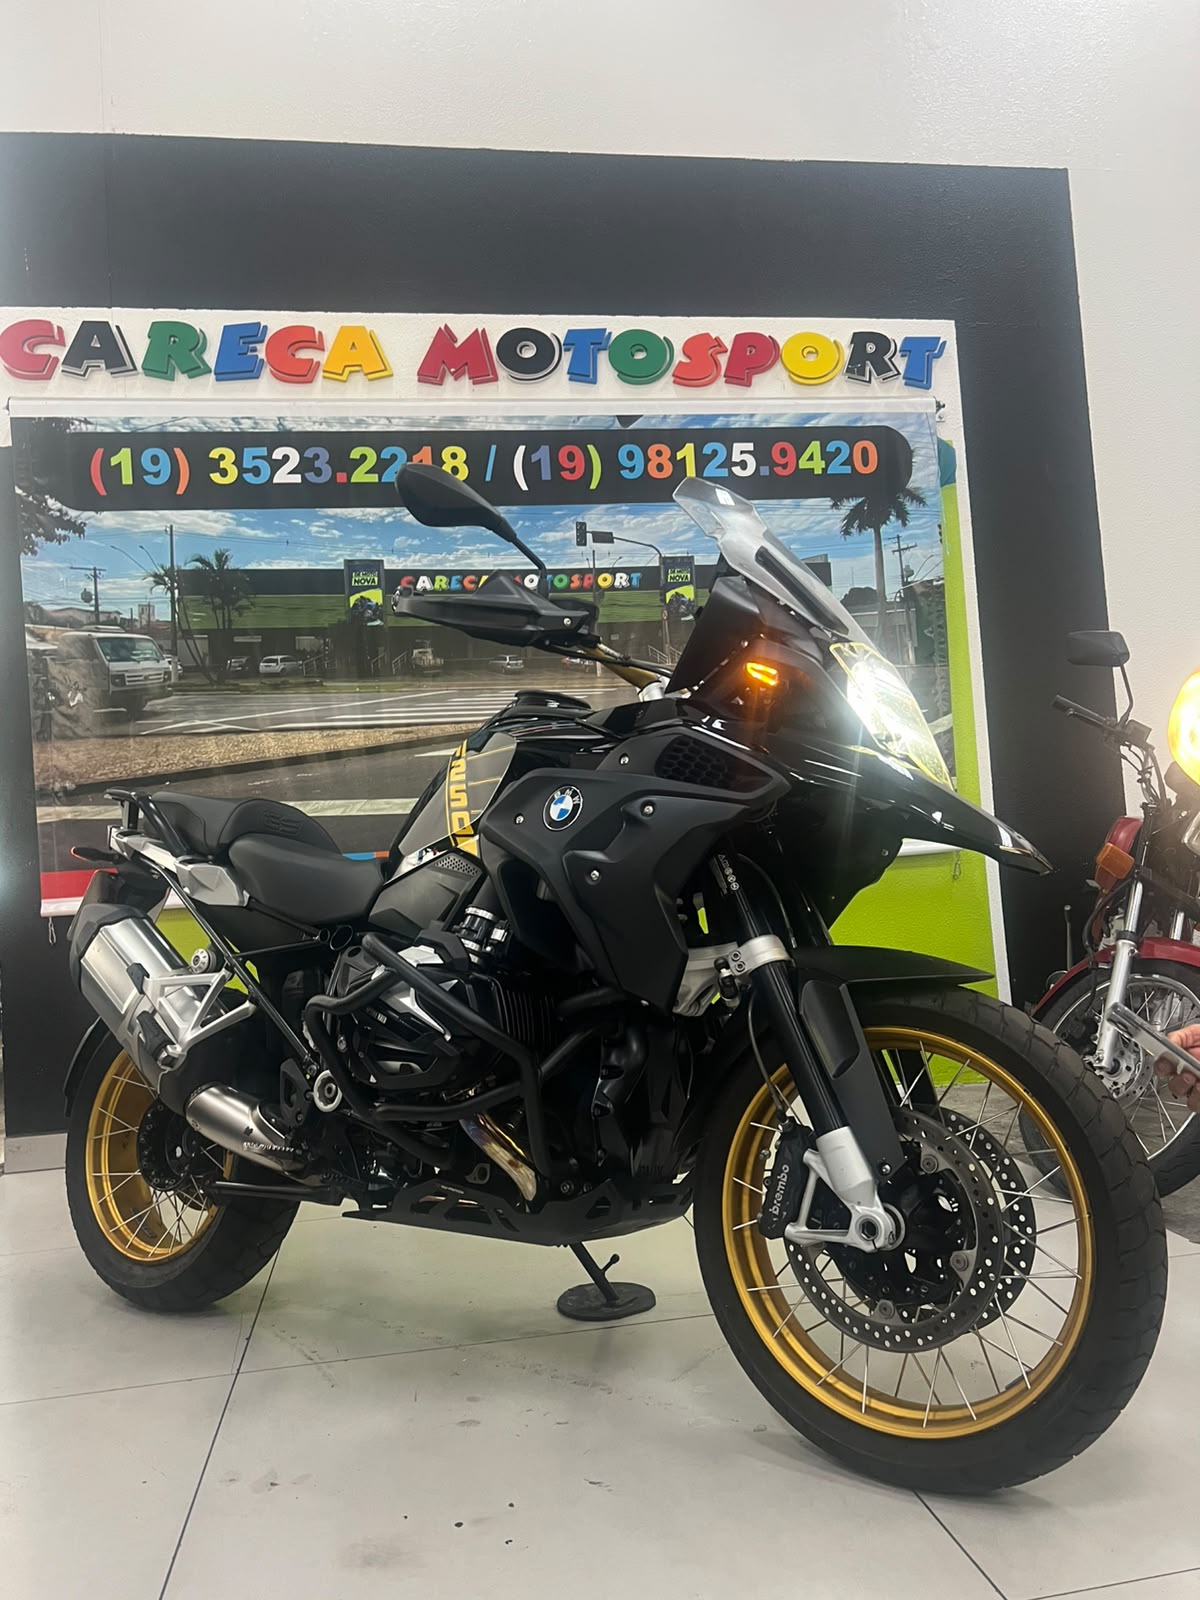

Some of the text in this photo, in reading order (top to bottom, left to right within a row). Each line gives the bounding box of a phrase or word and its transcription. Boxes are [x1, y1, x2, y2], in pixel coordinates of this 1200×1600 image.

[0, 318, 948, 390] CARECA MOTOSPORT
[90, 447, 190, 495] (19)
[513, 444, 601, 490] (19)
[617, 440, 878, 480] 98125.9420
[353, 577, 376, 585] NOVA
[400, 573, 641, 592] CAREC OOSPORT
[669, 574, 689, 582] NOVA
[769, 1164, 790, 1216] brembo
